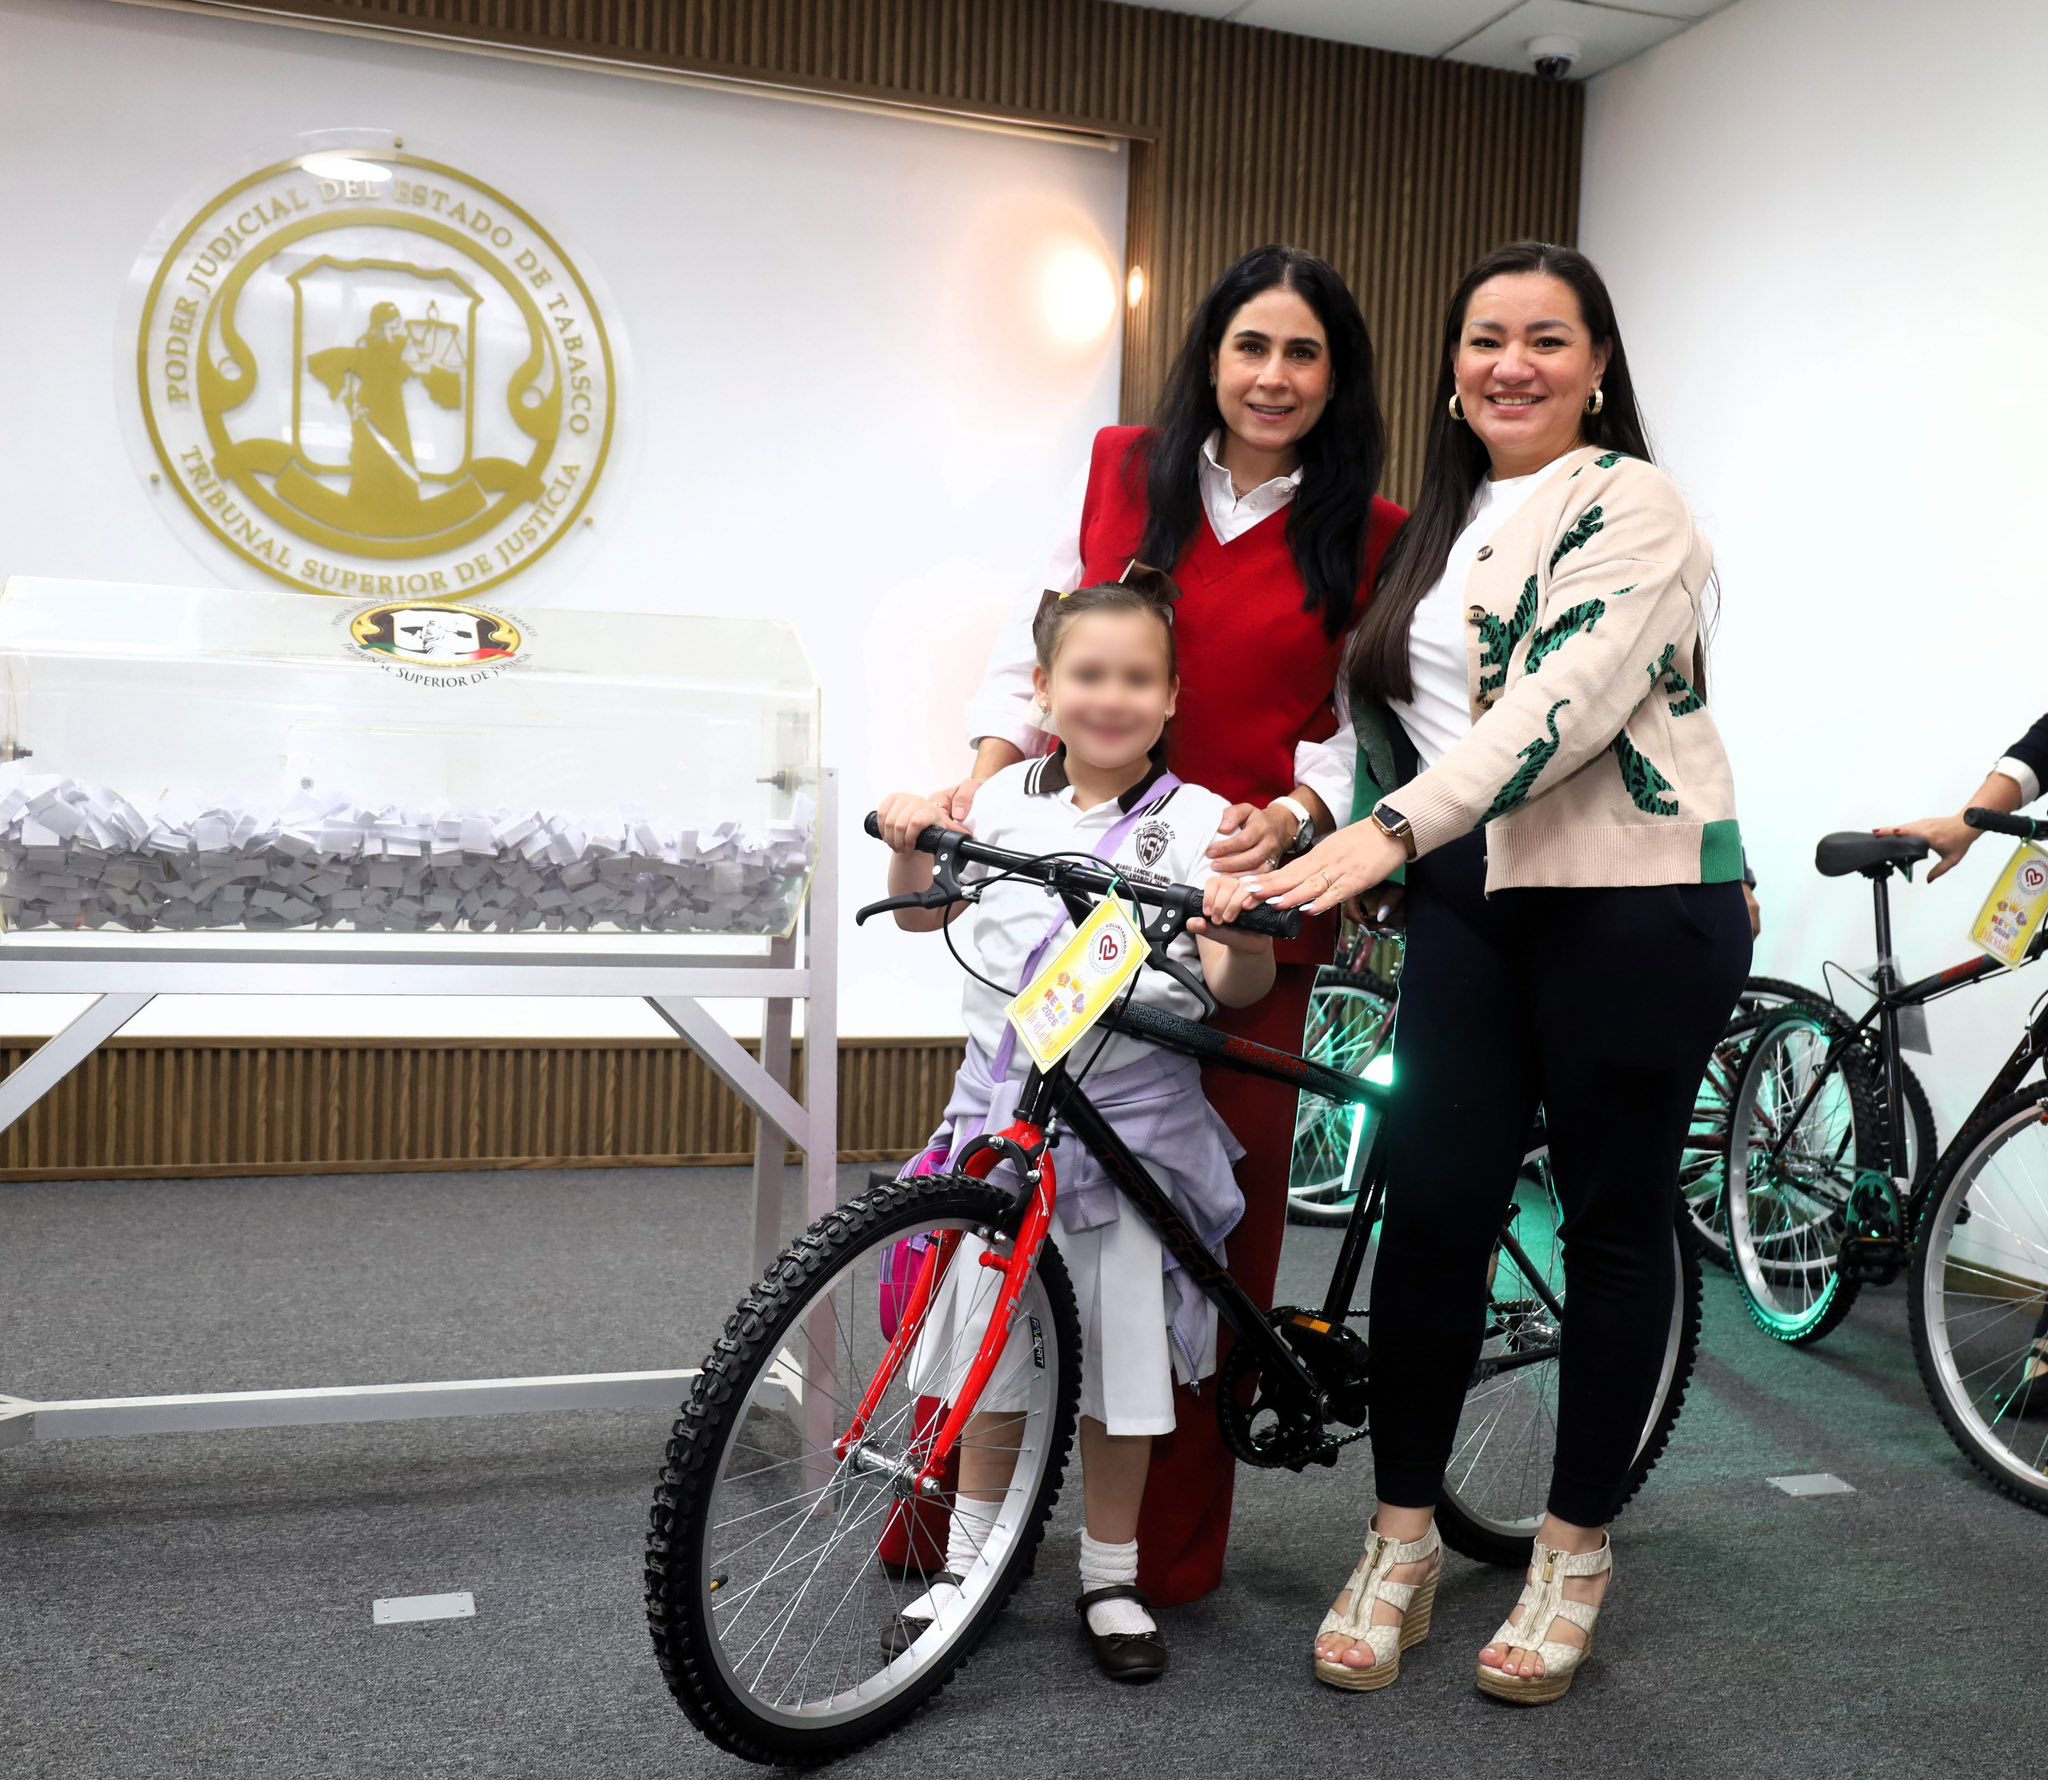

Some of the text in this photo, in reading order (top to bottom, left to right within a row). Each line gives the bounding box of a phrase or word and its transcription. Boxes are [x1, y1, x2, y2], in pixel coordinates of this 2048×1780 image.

[165, 177, 592, 434] PODER JUDICIAL DEL ESTADO DE TABASCO
[181, 445, 581, 595] TRIBUNAL SUPERIOR DE JUSTICIA
[396, 667, 469, 688] SUPERIOR
[471, 670, 490, 684] DE
[1041, 1003, 1059, 1027] 2026
[1044, 988, 1070, 1026] REYES
[1031, 1318, 1044, 1366] FAVORIT
